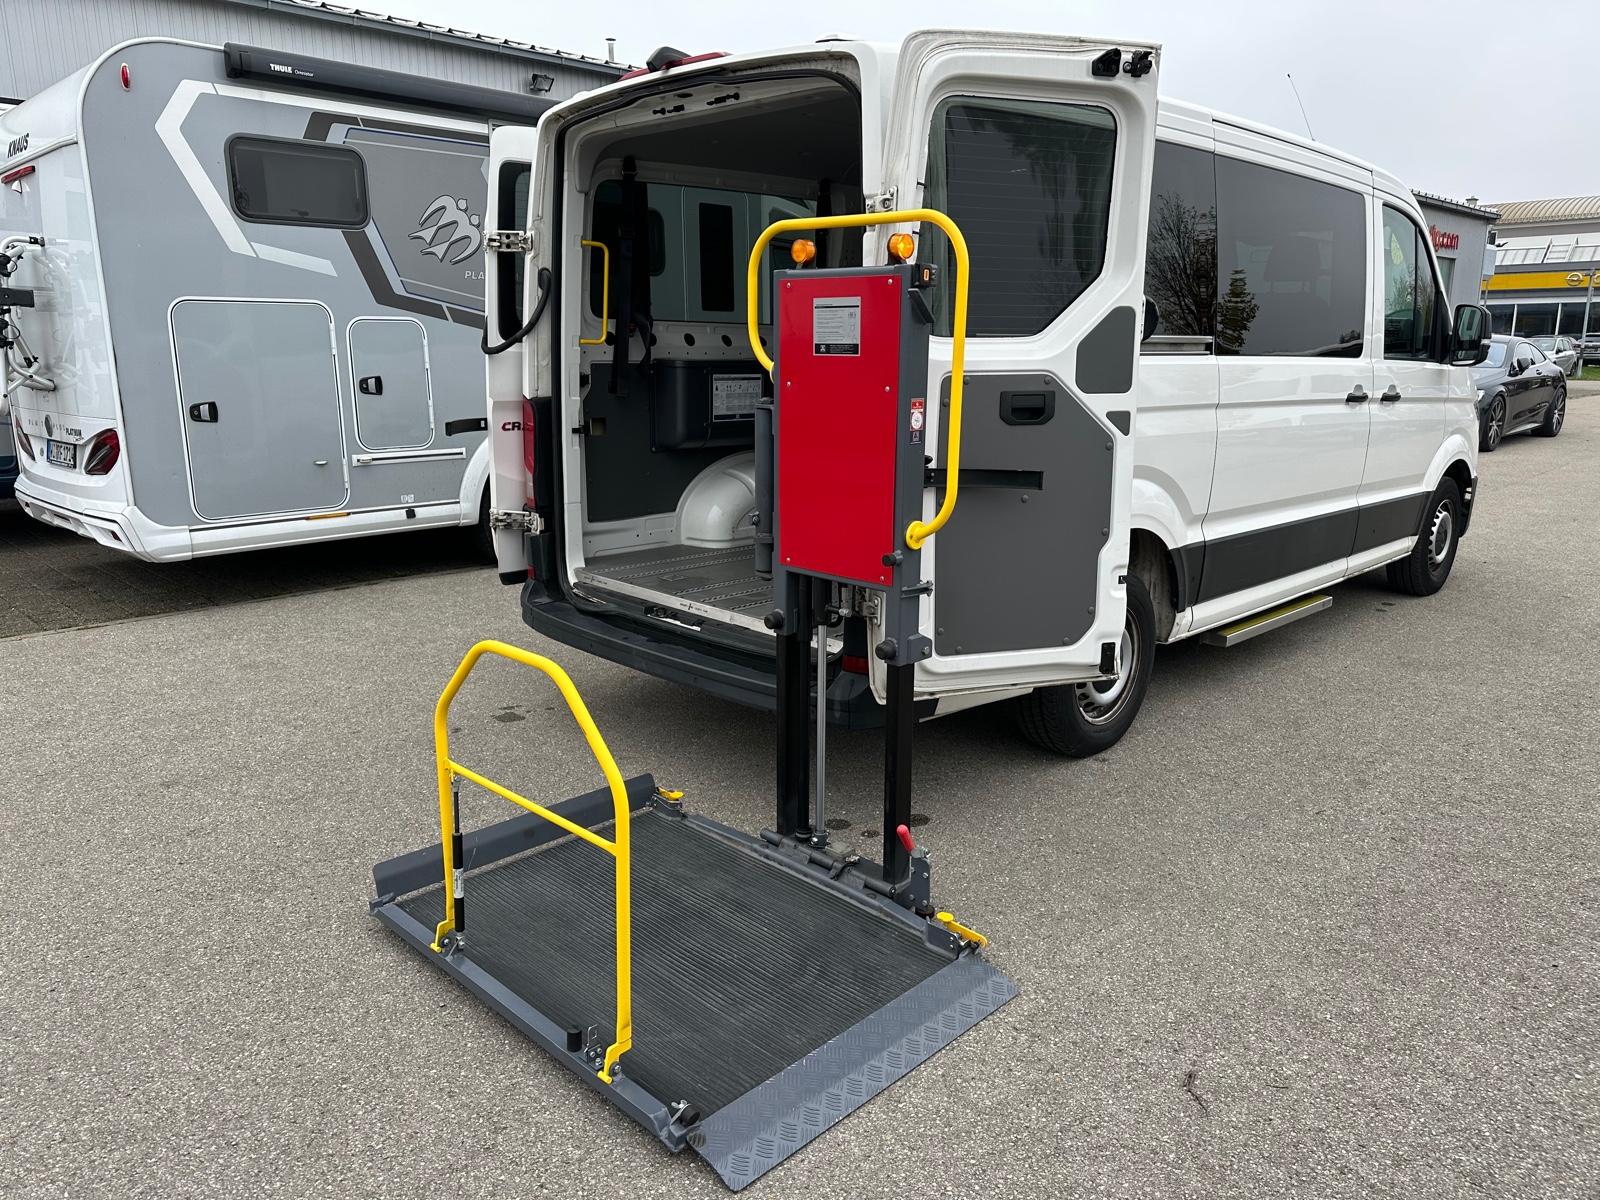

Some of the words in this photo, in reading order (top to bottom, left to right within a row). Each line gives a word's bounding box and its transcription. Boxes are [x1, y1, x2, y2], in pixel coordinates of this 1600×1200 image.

[269, 63, 293, 74] THULE
[8, 132, 30, 158] KNAUS
[501, 421, 524, 432] CR
